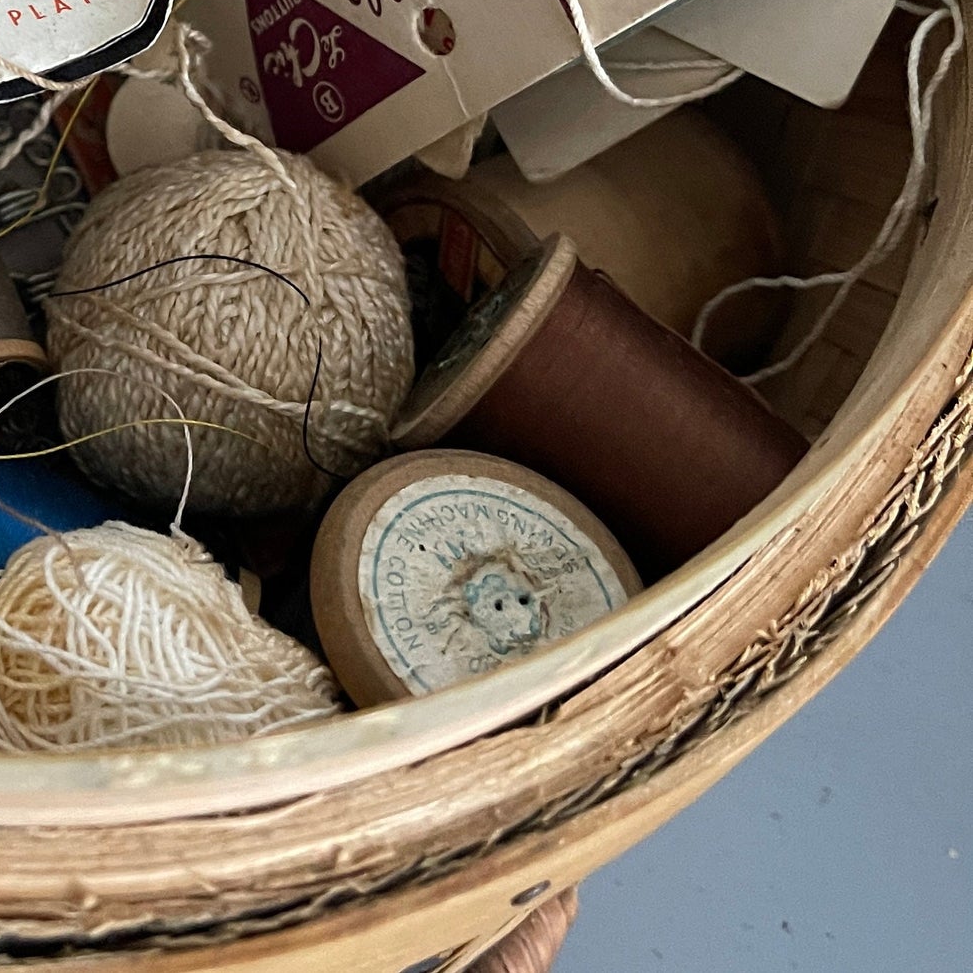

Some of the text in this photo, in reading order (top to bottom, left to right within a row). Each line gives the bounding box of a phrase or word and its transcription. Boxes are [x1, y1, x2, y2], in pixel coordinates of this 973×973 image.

[263, 17, 346, 88] Le Chic
[395, 503, 491, 553] MACHINE
[386, 555, 424, 652] COTTON
